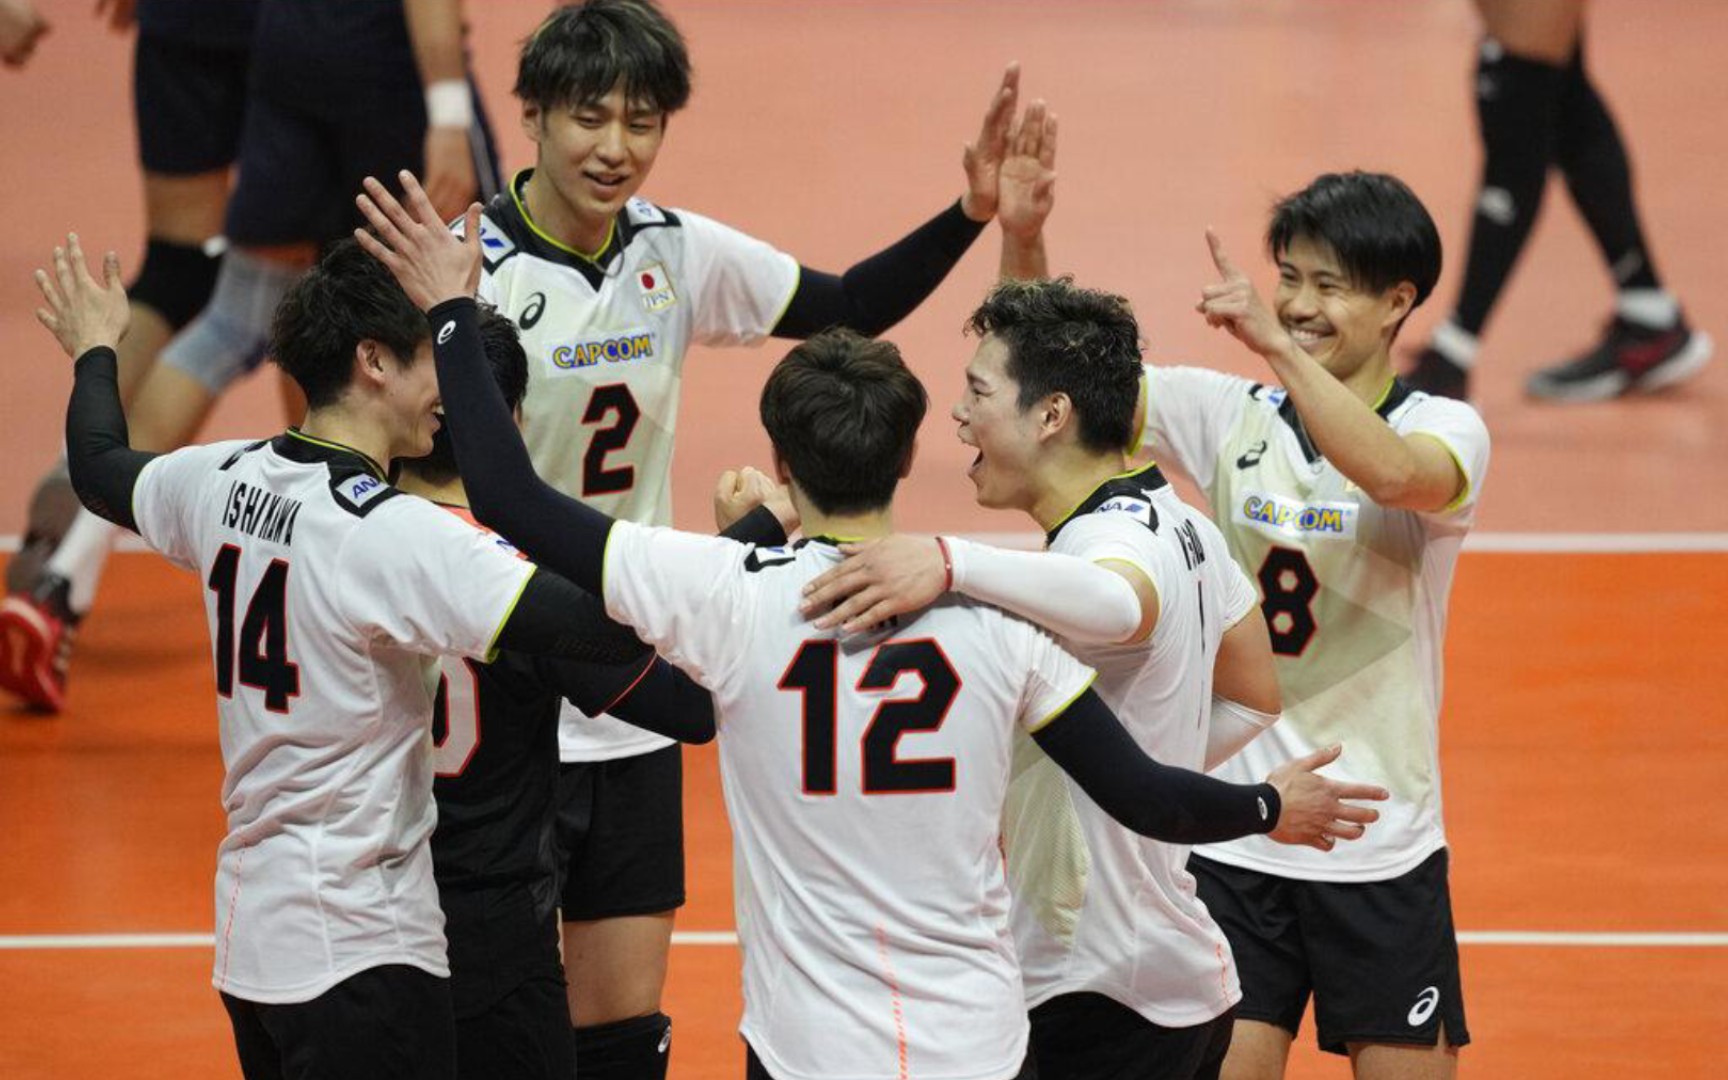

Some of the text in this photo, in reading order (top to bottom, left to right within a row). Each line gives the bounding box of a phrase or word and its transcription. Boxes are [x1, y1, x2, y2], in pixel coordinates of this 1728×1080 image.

[553, 333, 653, 368] CAPCOM
[580, 382, 641, 498] 2
[1243, 496, 1343, 533] CAPCOM
[208, 542, 300, 714] 14
[1257, 544, 1320, 657] 8
[776, 636, 962, 796] 12
